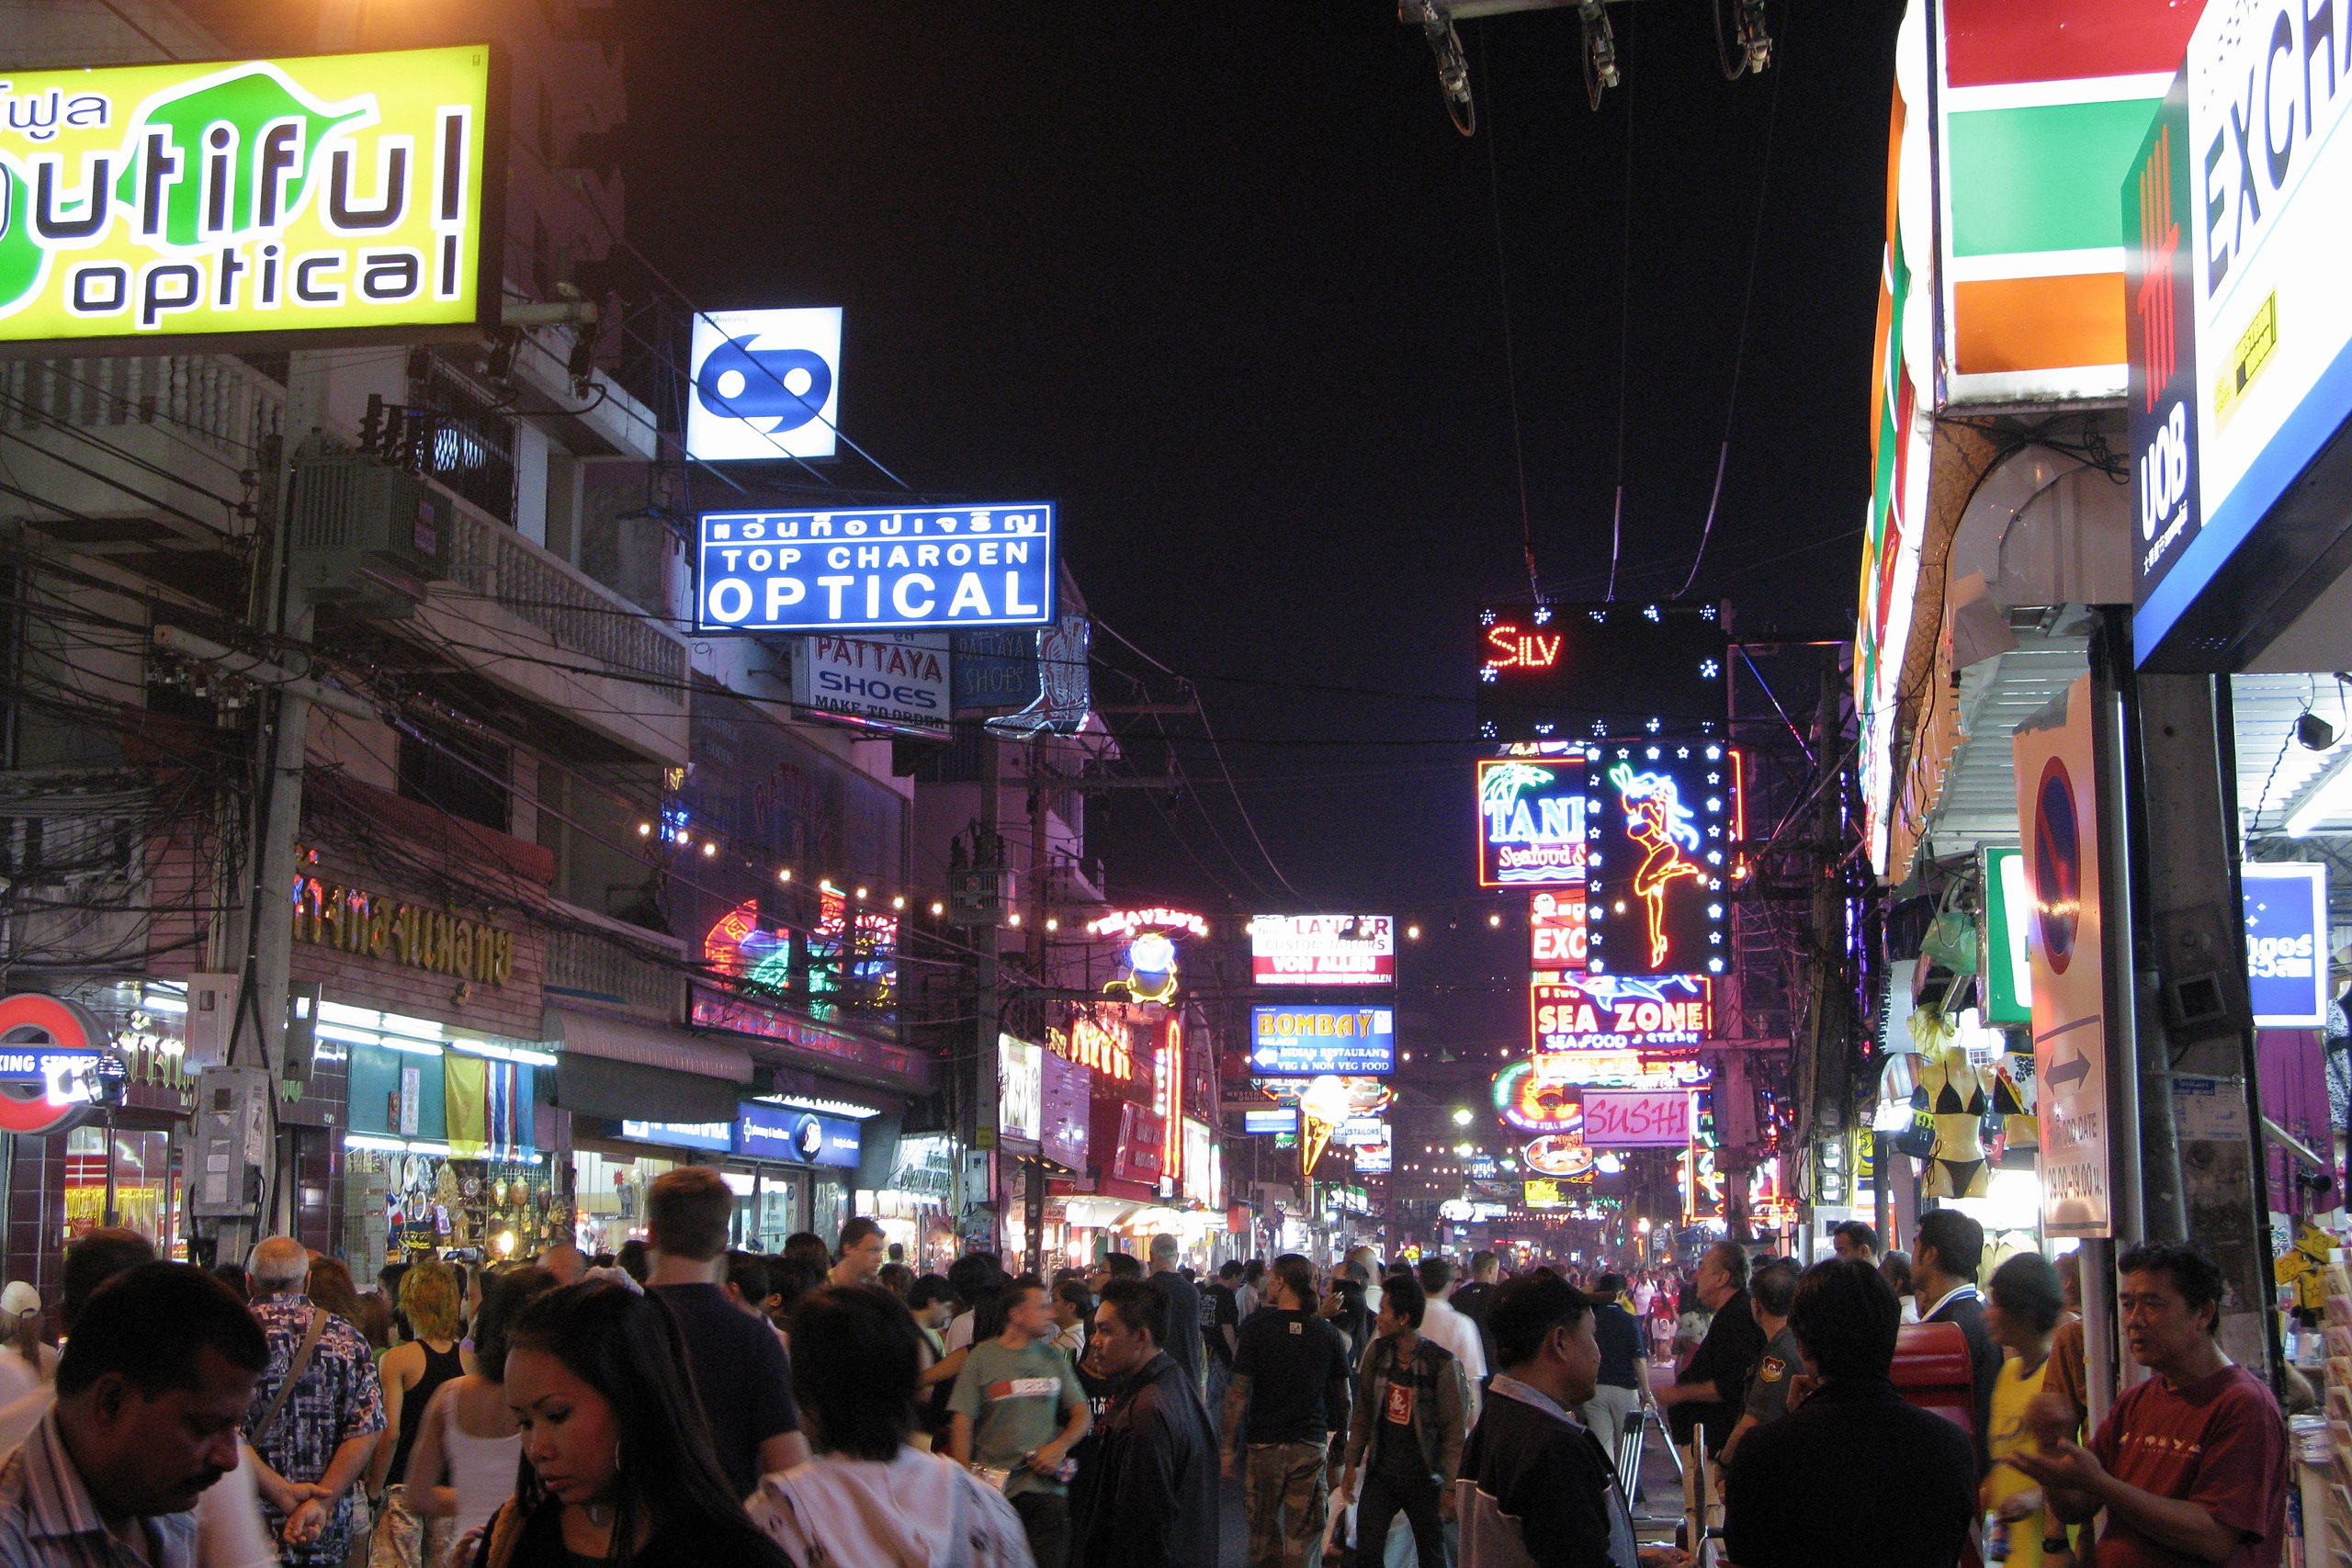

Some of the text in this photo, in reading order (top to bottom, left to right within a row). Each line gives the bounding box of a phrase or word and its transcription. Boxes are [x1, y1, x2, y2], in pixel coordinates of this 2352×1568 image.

[0, 83, 108, 140] ฟูล
[2205, 0, 2352, 300] EXCH
[74, 235, 458, 325] optical
[2141, 401, 2188, 541] UOB
[721, 542, 1029, 572] TOP CHAROEN
[708, 570, 1039, 624] OPTICAL
[815, 634, 943, 683] PATTAYA
[1488, 626, 1561, 667] SILV
[819, 670, 937, 709] SHOES
[814, 694, 861, 714] MAKE
[867, 704, 888, 720] TO
[1498, 843, 1572, 867] Seafood
[1272, 955, 1314, 972] VON
[1257, 1013, 1374, 1038] BOMBAY
[1537, 1002, 1704, 1033] SEA ZONE
[1280, 1047, 1388, 1058] INDIAN RESTAURANT
[1545, 1033, 1628, 1049] SEAFOOD
[1277, 1061, 1389, 1071] VEG & NON VEG FOOD
[1353, 1128, 1380, 1136] TAILORS
[1586, 1098, 1690, 1135] SUSHI
